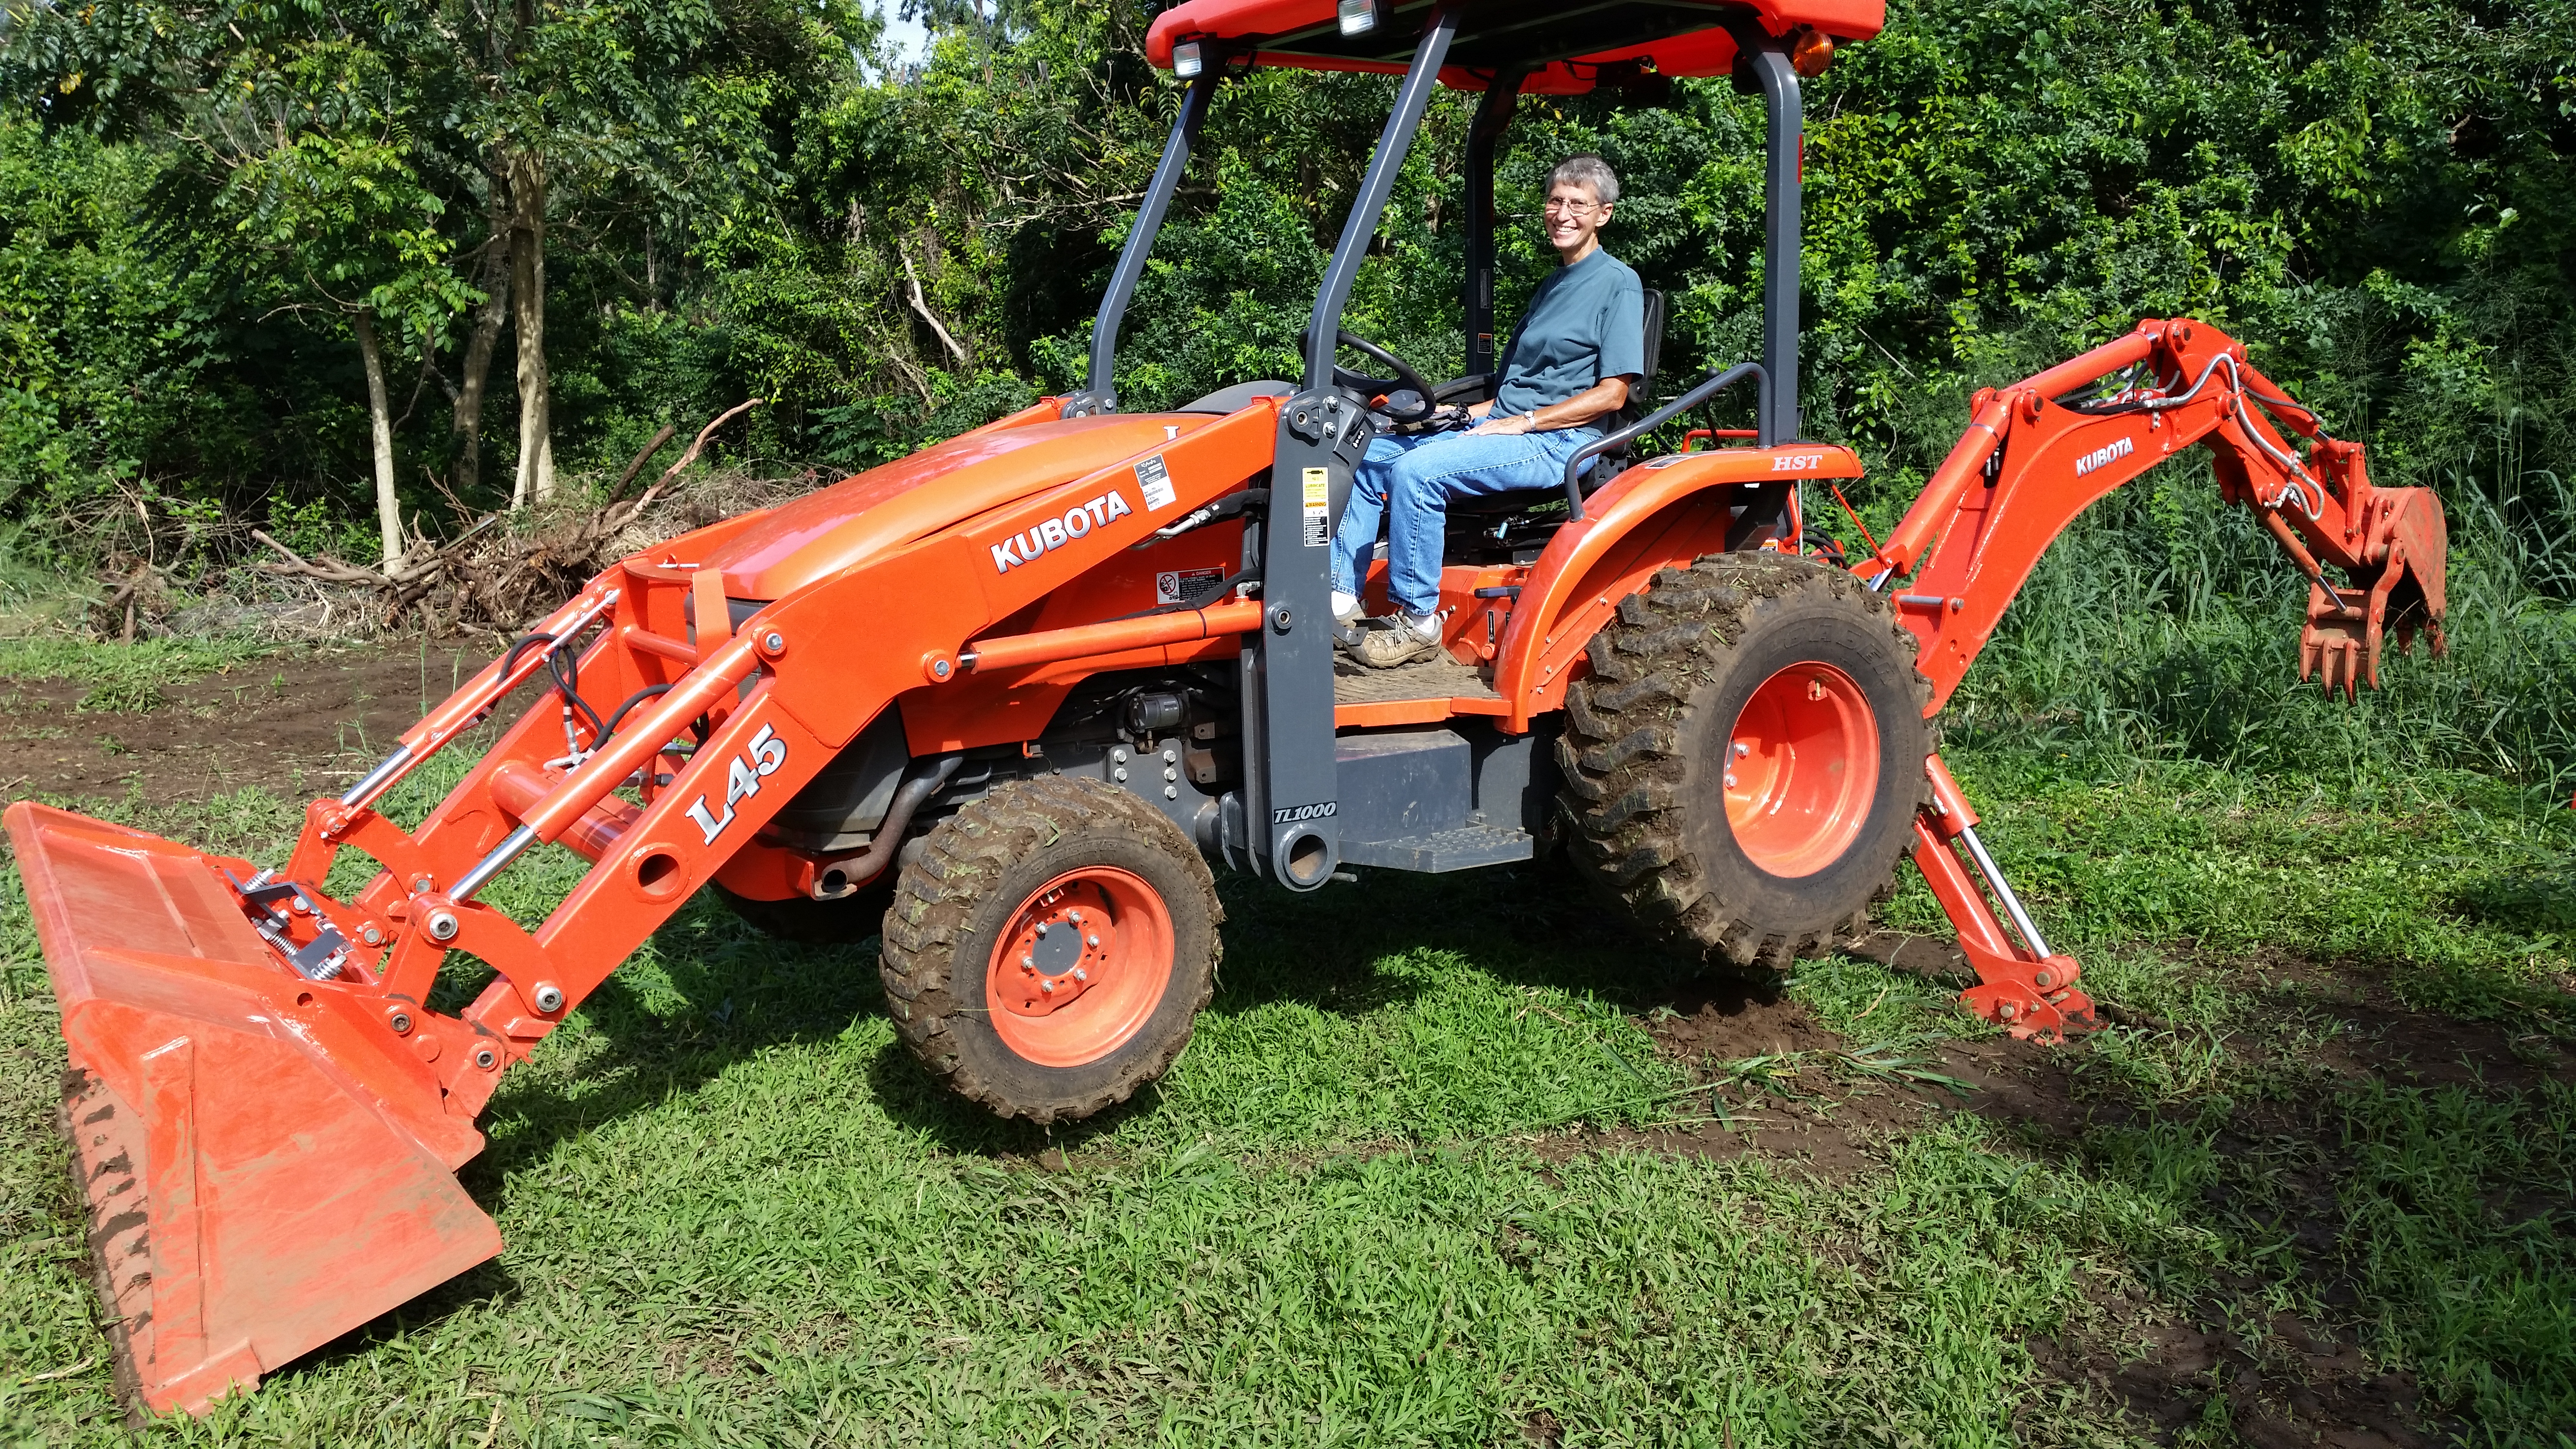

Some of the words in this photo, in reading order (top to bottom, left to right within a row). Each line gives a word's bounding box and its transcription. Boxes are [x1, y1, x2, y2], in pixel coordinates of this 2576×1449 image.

[1771, 455, 1822, 471] HST
[2076, 436, 2134, 478] KUBOTA
[990, 490, 1132, 575] KUBOTA
[685, 722, 787, 846] L45
[1274, 802, 1336, 823] TL1000
